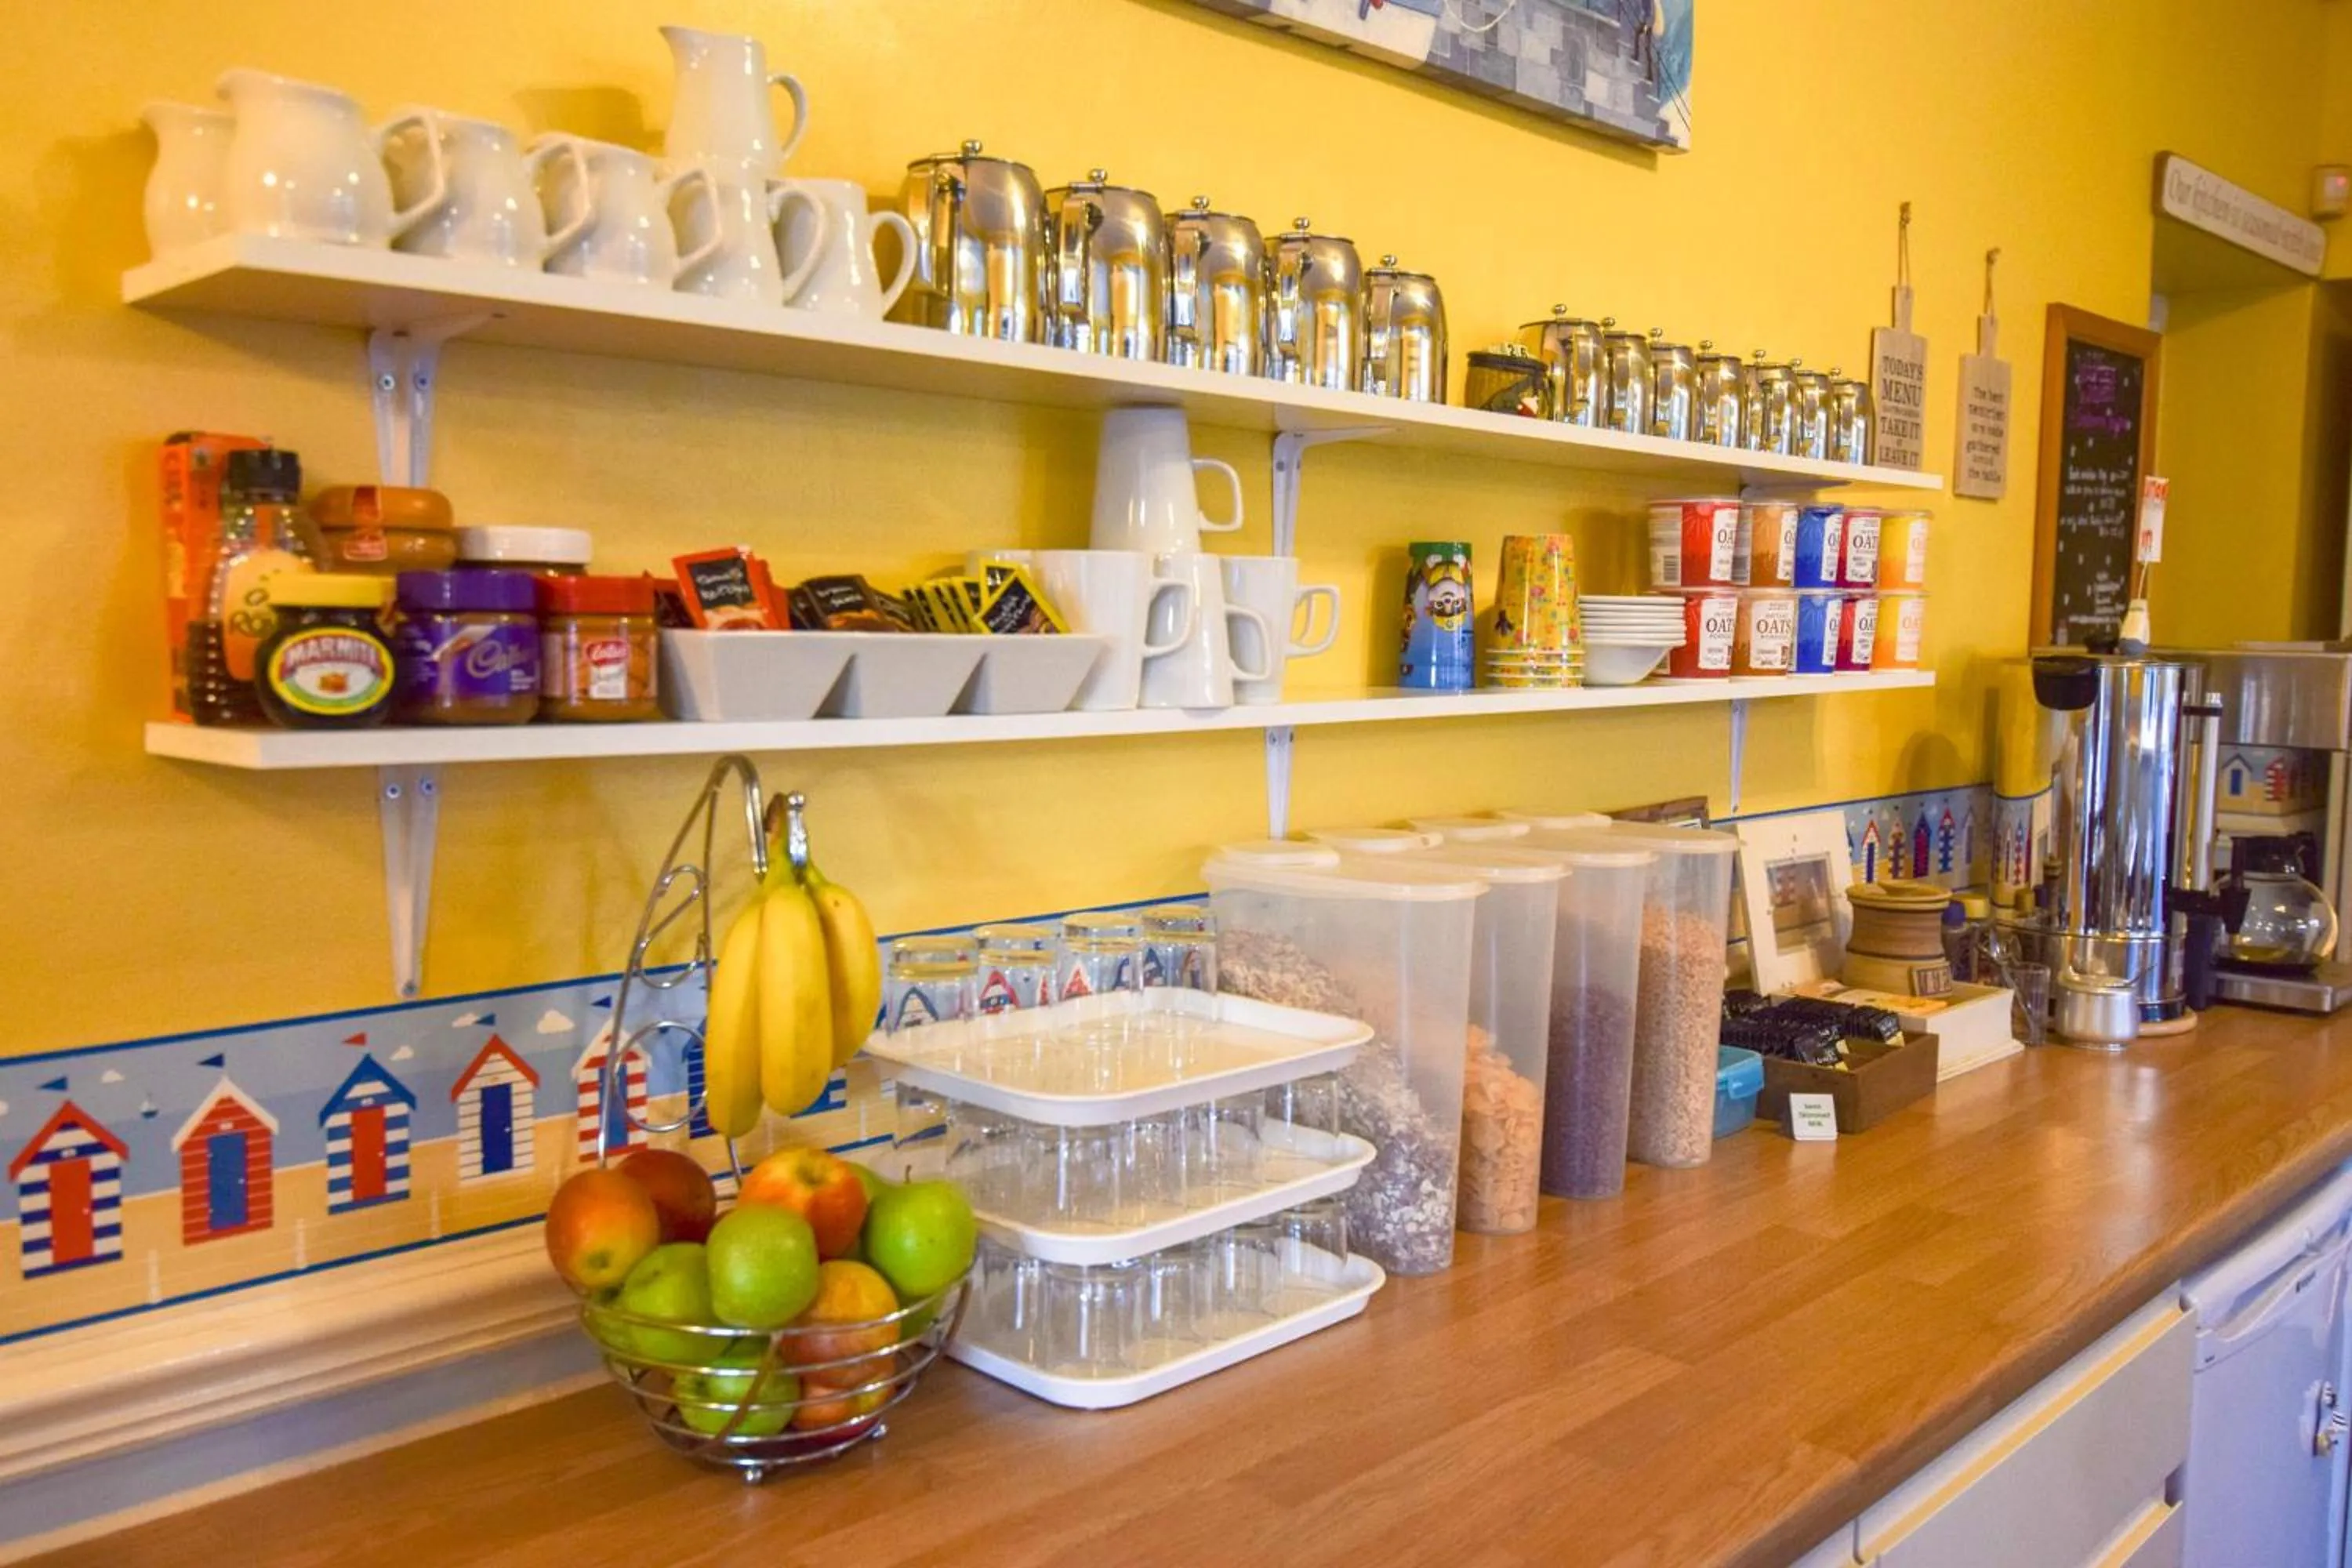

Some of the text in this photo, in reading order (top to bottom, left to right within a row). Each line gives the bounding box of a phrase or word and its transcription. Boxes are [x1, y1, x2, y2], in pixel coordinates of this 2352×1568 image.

[1882, 355, 1923, 381] TODAY'S
[1882, 378, 1922, 407] MENU
[1880, 416, 1920, 439] TAKE IT
[1879, 445, 1919, 466] LEAVE IT
[1853, 535, 1878, 550] OAT
[1706, 618, 1733, 633] OAT
[286, 637, 378, 666] MARMITE
